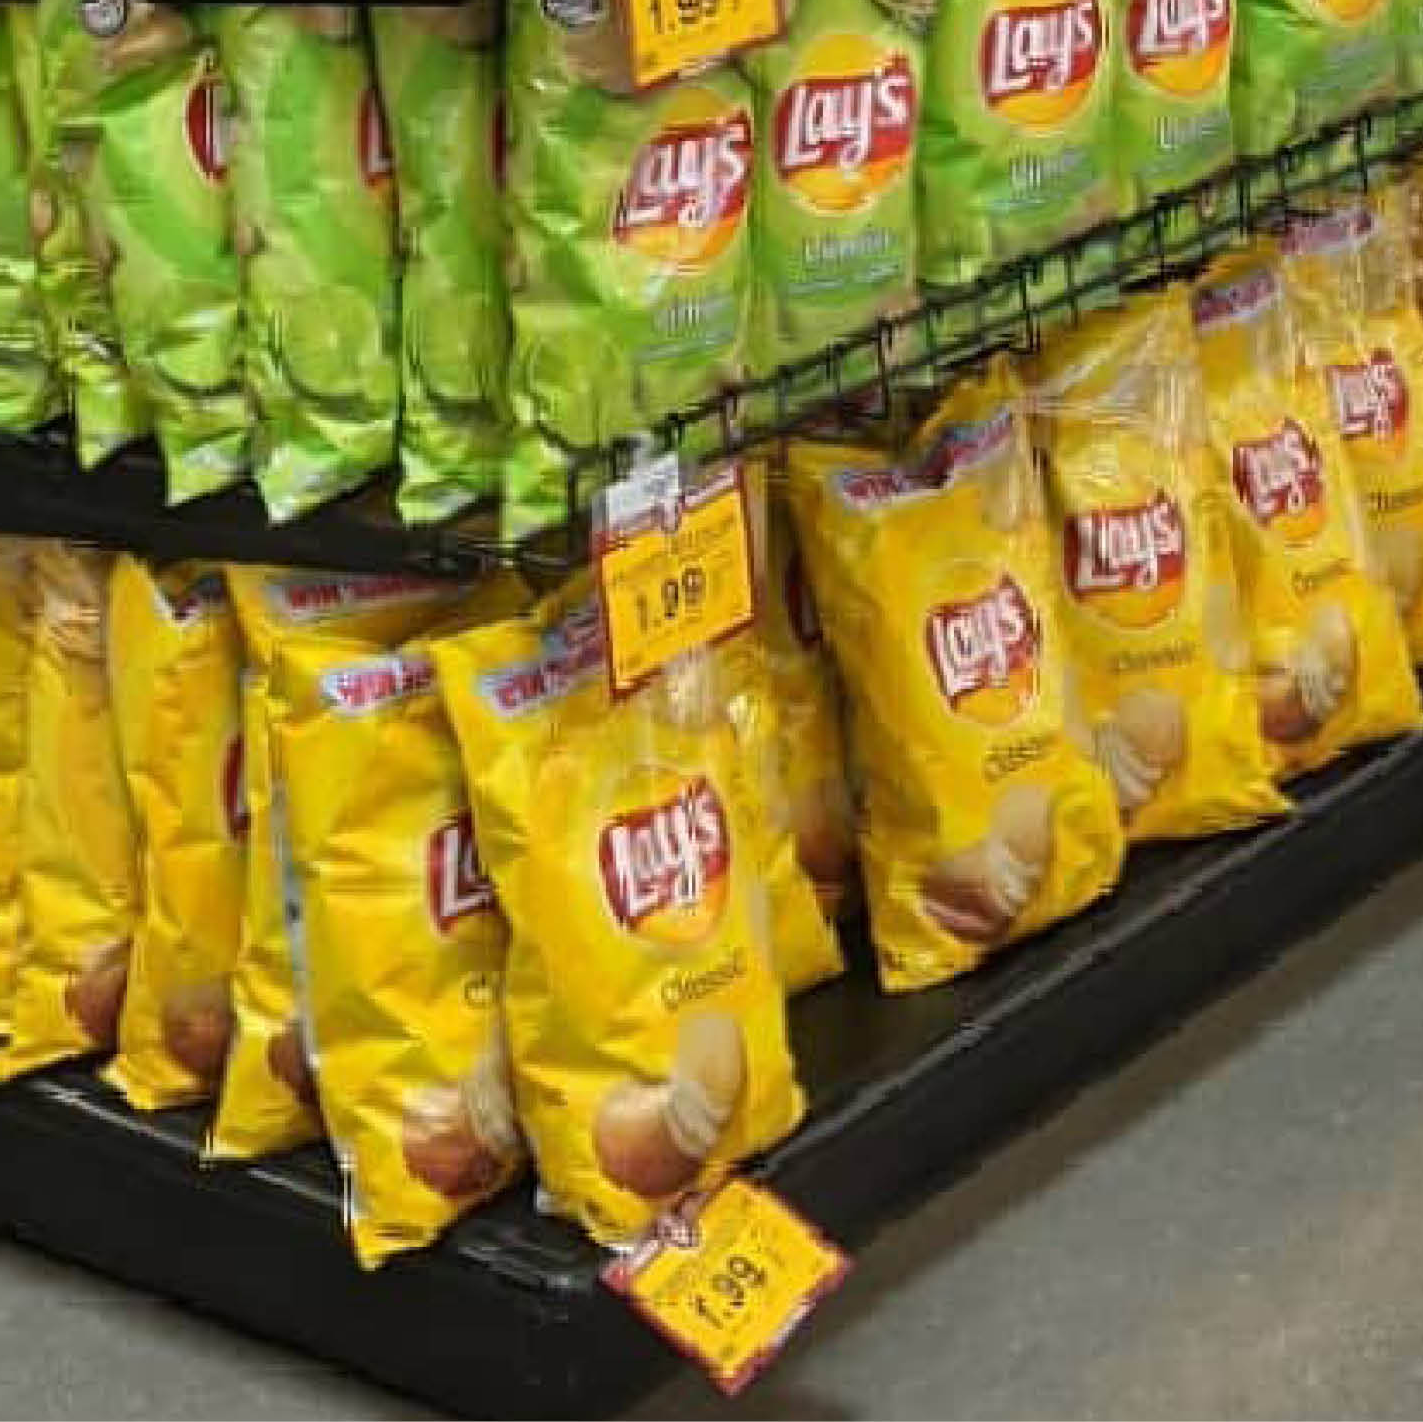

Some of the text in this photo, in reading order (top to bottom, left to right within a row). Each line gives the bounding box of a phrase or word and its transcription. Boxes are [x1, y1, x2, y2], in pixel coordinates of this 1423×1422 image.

[778, 61, 912, 170] Lay's
[618, 120, 750, 229] Lay's
[1242, 427, 1320, 521] Lay's
[1073, 499, 1184, 593] Lay's
[634, 565, 706, 633] 1.99
[928, 582, 1036, 699] Lay's
[604, 780, 724, 921] Lay's
[694, 1253, 770, 1330] 1.99
